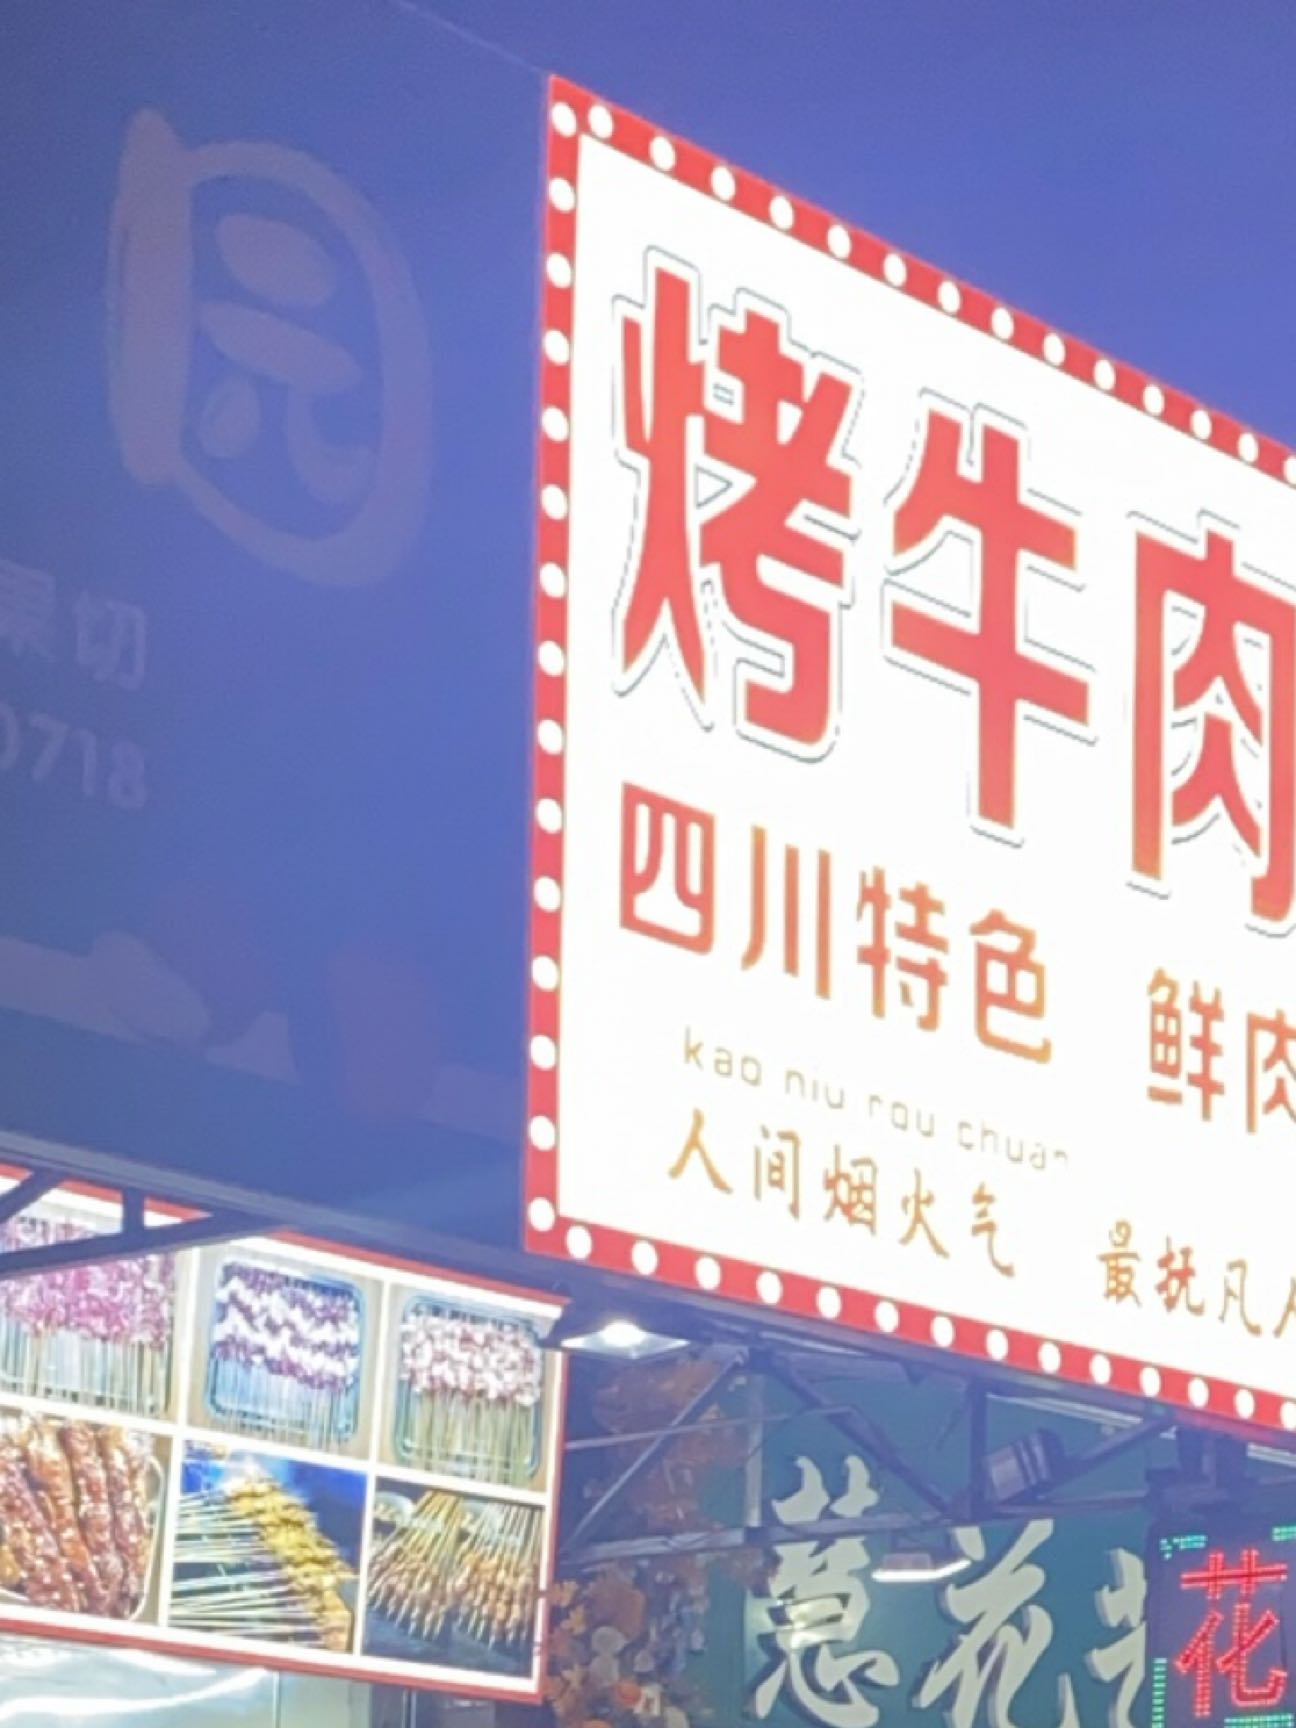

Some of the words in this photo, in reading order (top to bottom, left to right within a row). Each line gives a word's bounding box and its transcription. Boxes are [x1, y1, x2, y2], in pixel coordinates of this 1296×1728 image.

[617, 781, 1053, 1065] 四川特色
[684, 1026, 763, 1087] kao
[784, 1068, 845, 1110] niu
[868, 1093, 936, 1138] rou
[668, 1106, 1016, 1279] 人间烟火气
